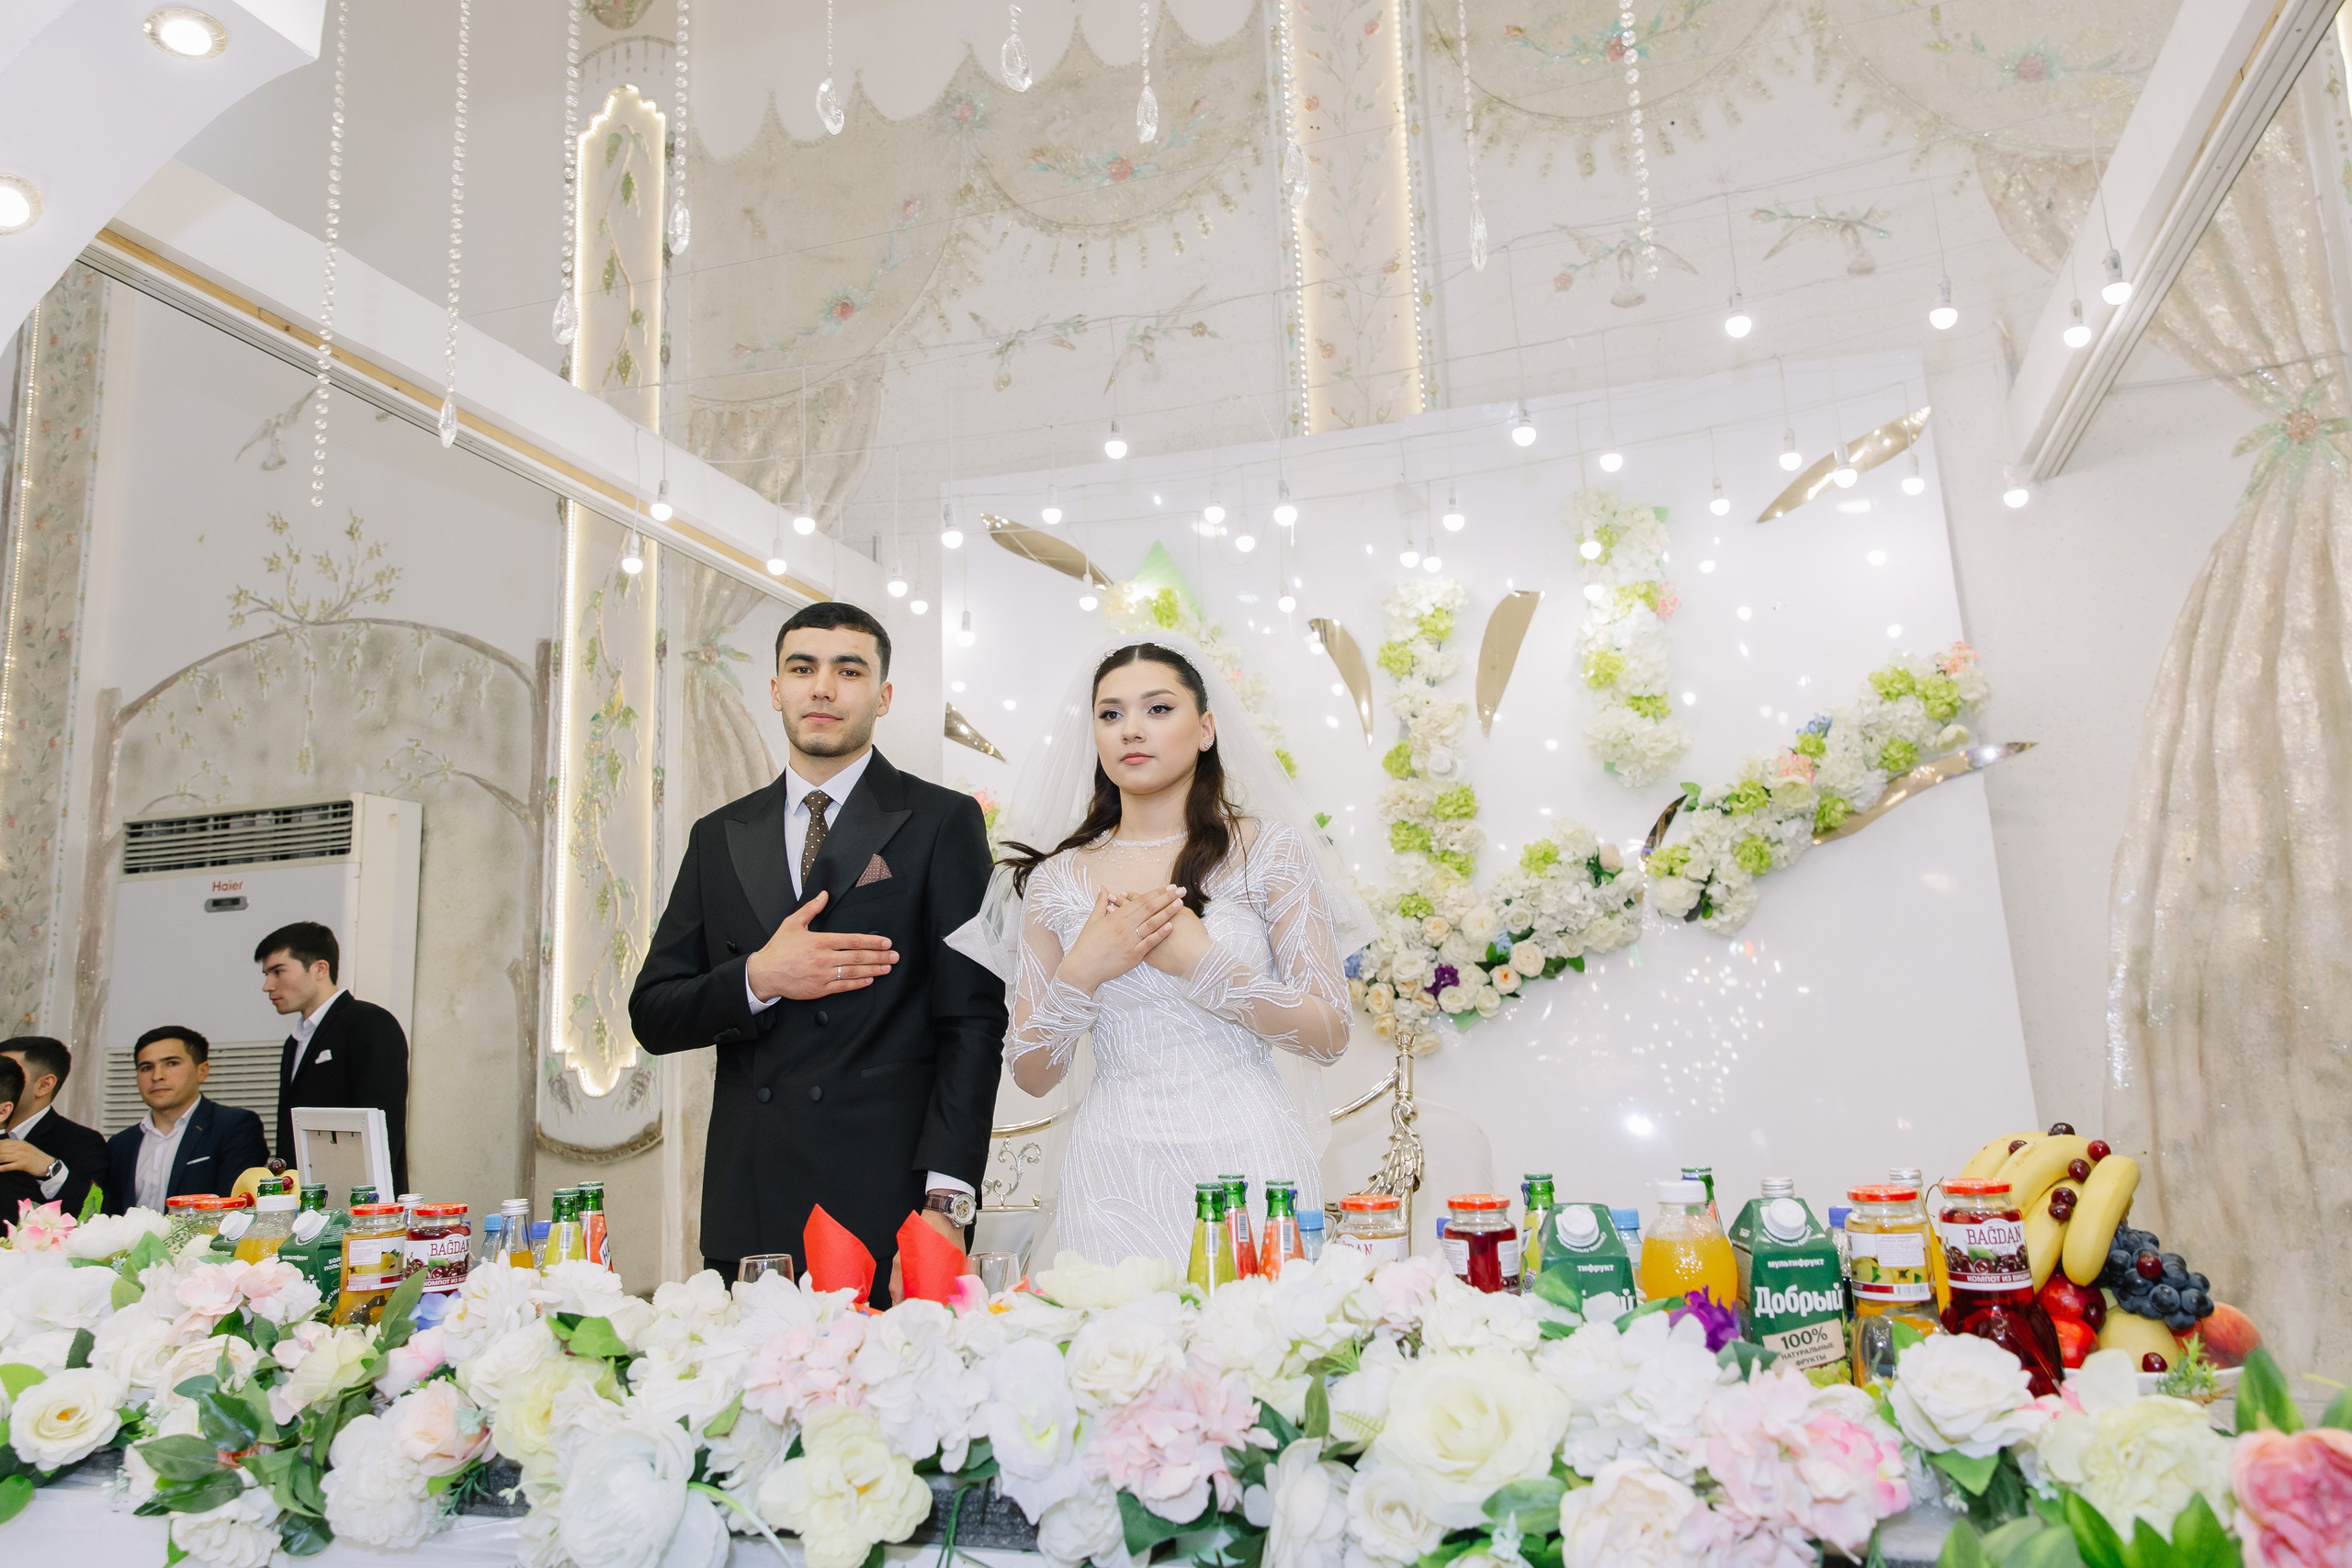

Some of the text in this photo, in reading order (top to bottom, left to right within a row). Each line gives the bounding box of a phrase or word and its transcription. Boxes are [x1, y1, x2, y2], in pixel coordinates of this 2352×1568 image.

[212, 879, 243, 892] Haier
[1577, 1263, 1614, 1273] тифрукт
[1767, 1258, 1825, 1269] мультифрукт
[2001, 1274, 2012, 1282] ИЗ
[1754, 1282, 1845, 1319] Добрый
[1781, 1325, 1828, 1350] 100%
[1781, 1341, 1835, 1360] НАТУРАЛЬНЫЕ
[1795, 1354, 1826, 1367] ФРУКТЫ
